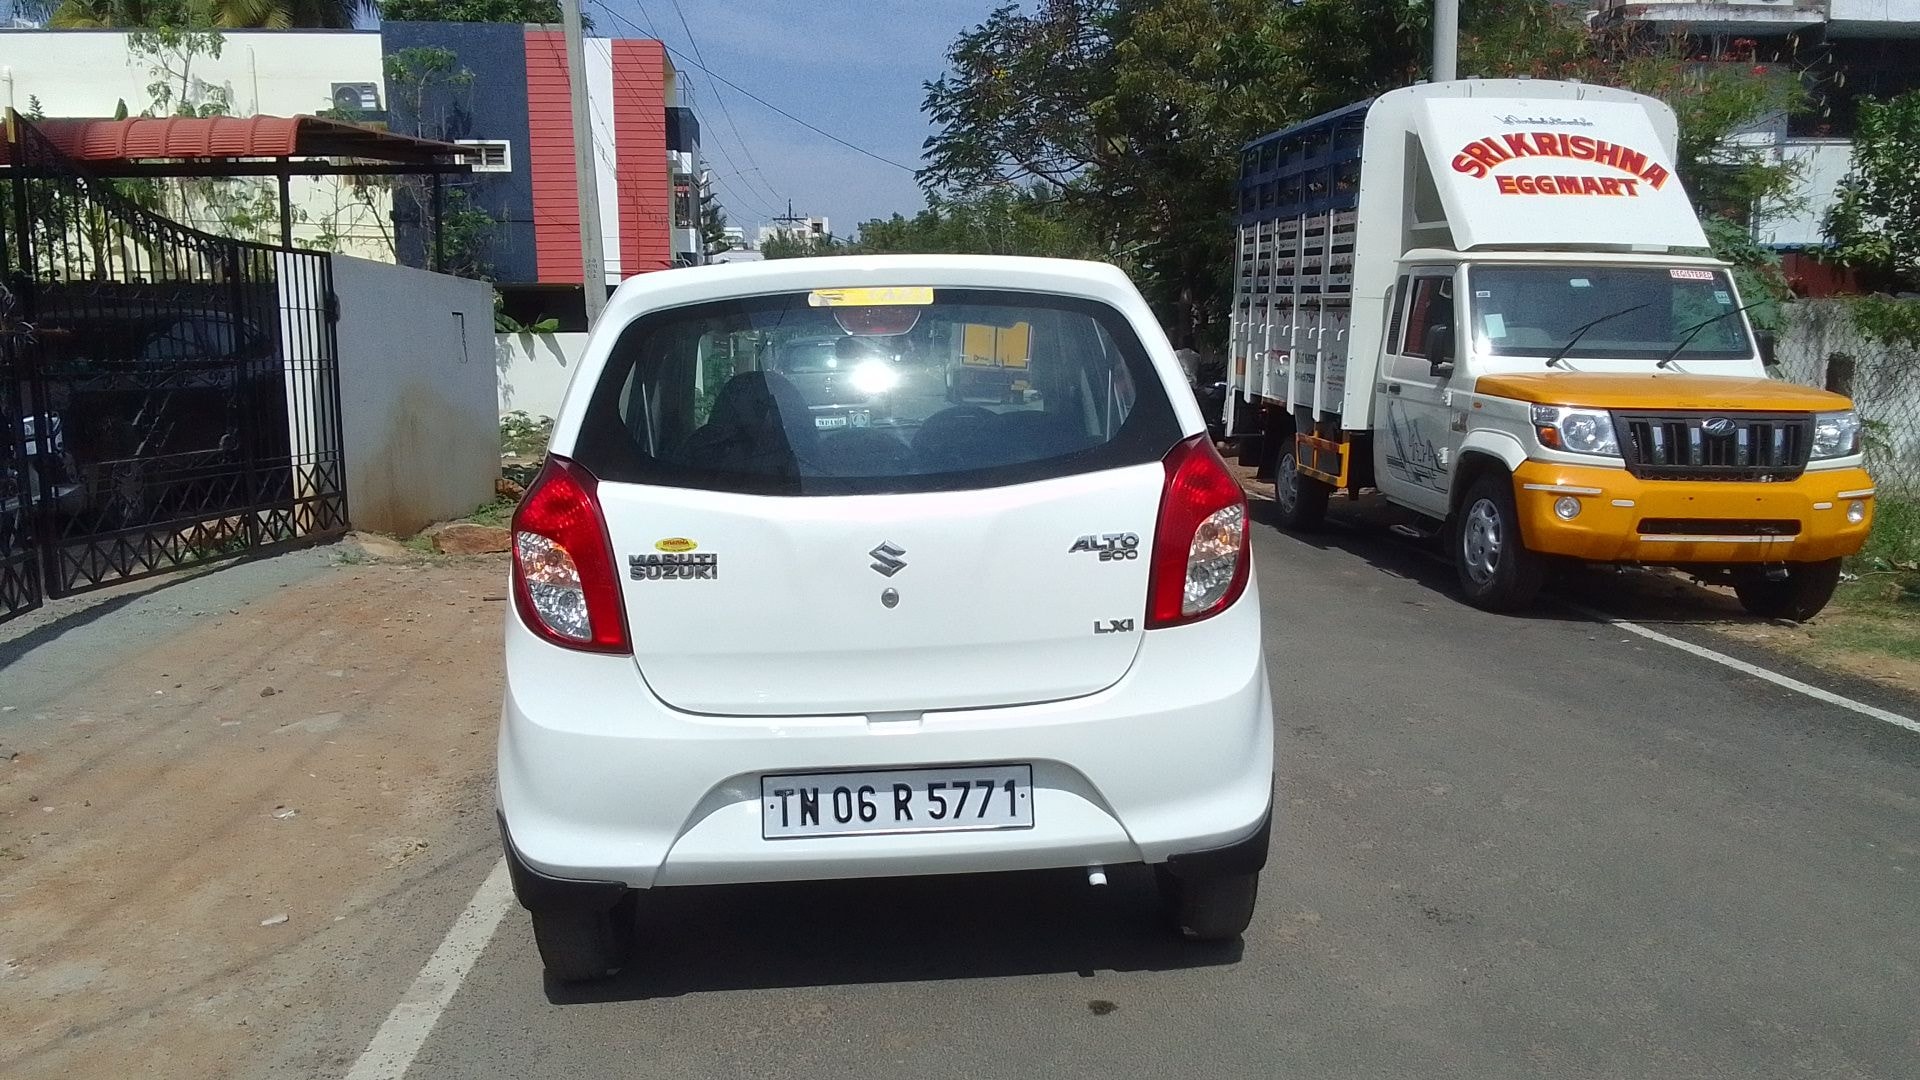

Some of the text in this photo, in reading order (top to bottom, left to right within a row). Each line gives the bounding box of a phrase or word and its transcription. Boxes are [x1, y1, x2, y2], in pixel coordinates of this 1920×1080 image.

[1495, 174, 1639, 196] EGGMART
[1670, 270, 1712, 279] REGISTERED
[1068, 532, 1139, 553] ALTO
[628, 553, 718, 566] MARUTI
[1099, 549, 1138, 561] 800
[629, 565, 718, 580] SUZUKI
[1094, 619, 1134, 634] LXI
[775, 779, 1016, 827] TN 06 R 5771
